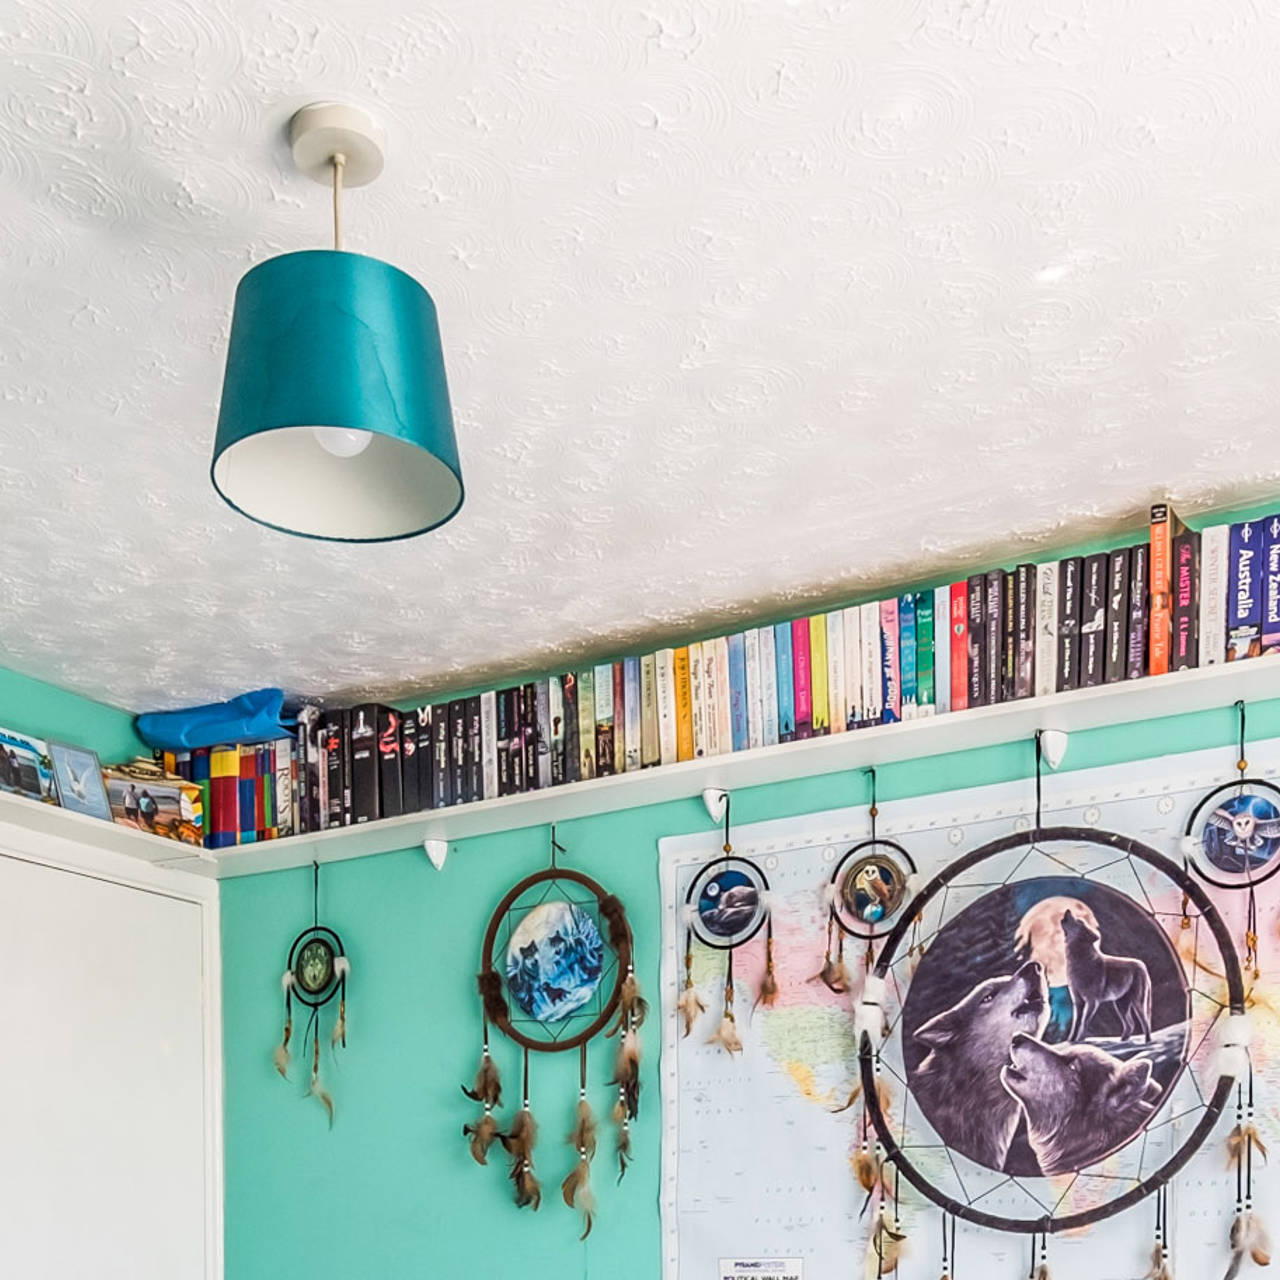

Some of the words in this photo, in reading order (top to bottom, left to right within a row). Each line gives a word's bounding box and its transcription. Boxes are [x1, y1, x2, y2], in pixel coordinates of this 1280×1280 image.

[1114, 555, 1123, 571] This
[1180, 544, 1191, 564] The
[1114, 572, 1122, 590] Man
[1179, 566, 1189, 607] MISTER
[1237, 549, 1256, 619] Australia
[1179, 631, 1187, 657] James
[885, 682, 897, 709] GOOD
[278, 767, 290, 812] ROOTS
